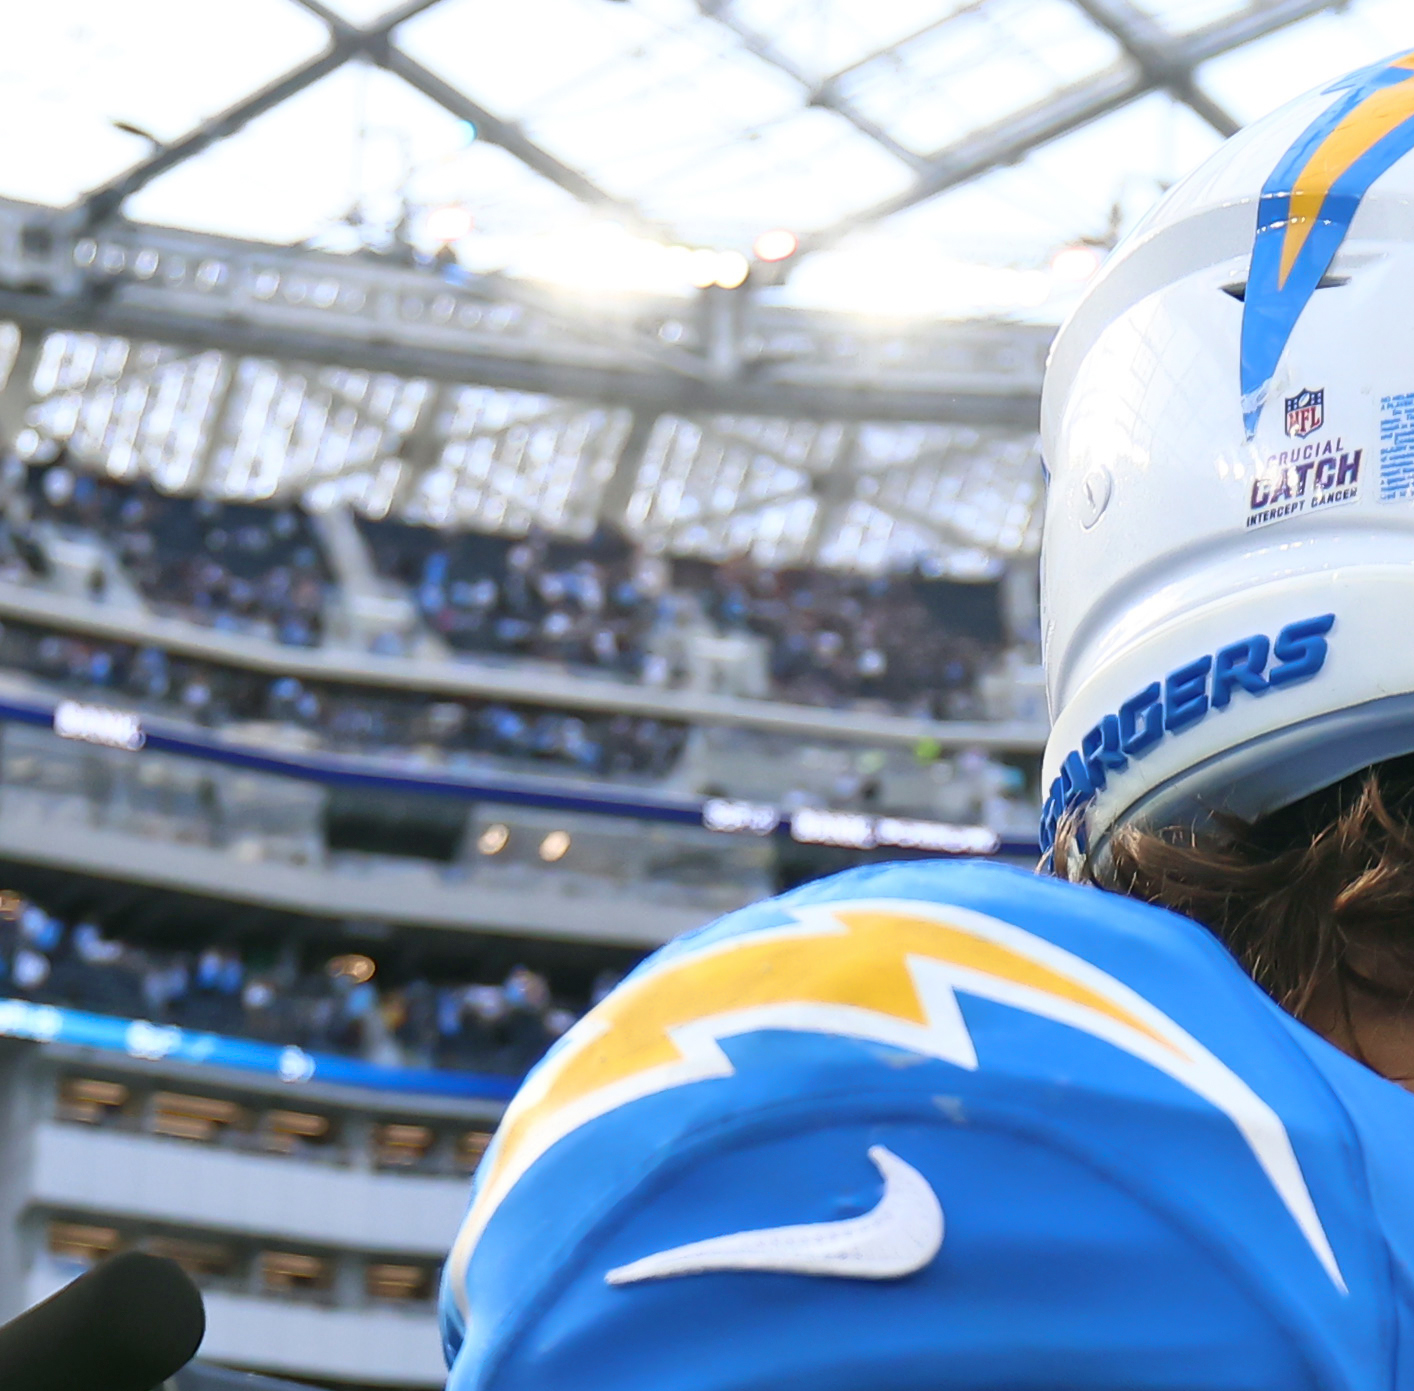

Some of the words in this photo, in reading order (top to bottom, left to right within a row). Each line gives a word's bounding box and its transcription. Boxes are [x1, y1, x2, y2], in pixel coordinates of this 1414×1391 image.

[1288, 406, 1320, 433] NFL
[1266, 437, 1344, 467] CRUCIAL
[1250, 448, 1363, 510] CATCH
[1311, 487, 1358, 509] CANCER
[1246, 500, 1305, 528] INTERCEPT
[1038, 613, 1336, 862] ARGERS
